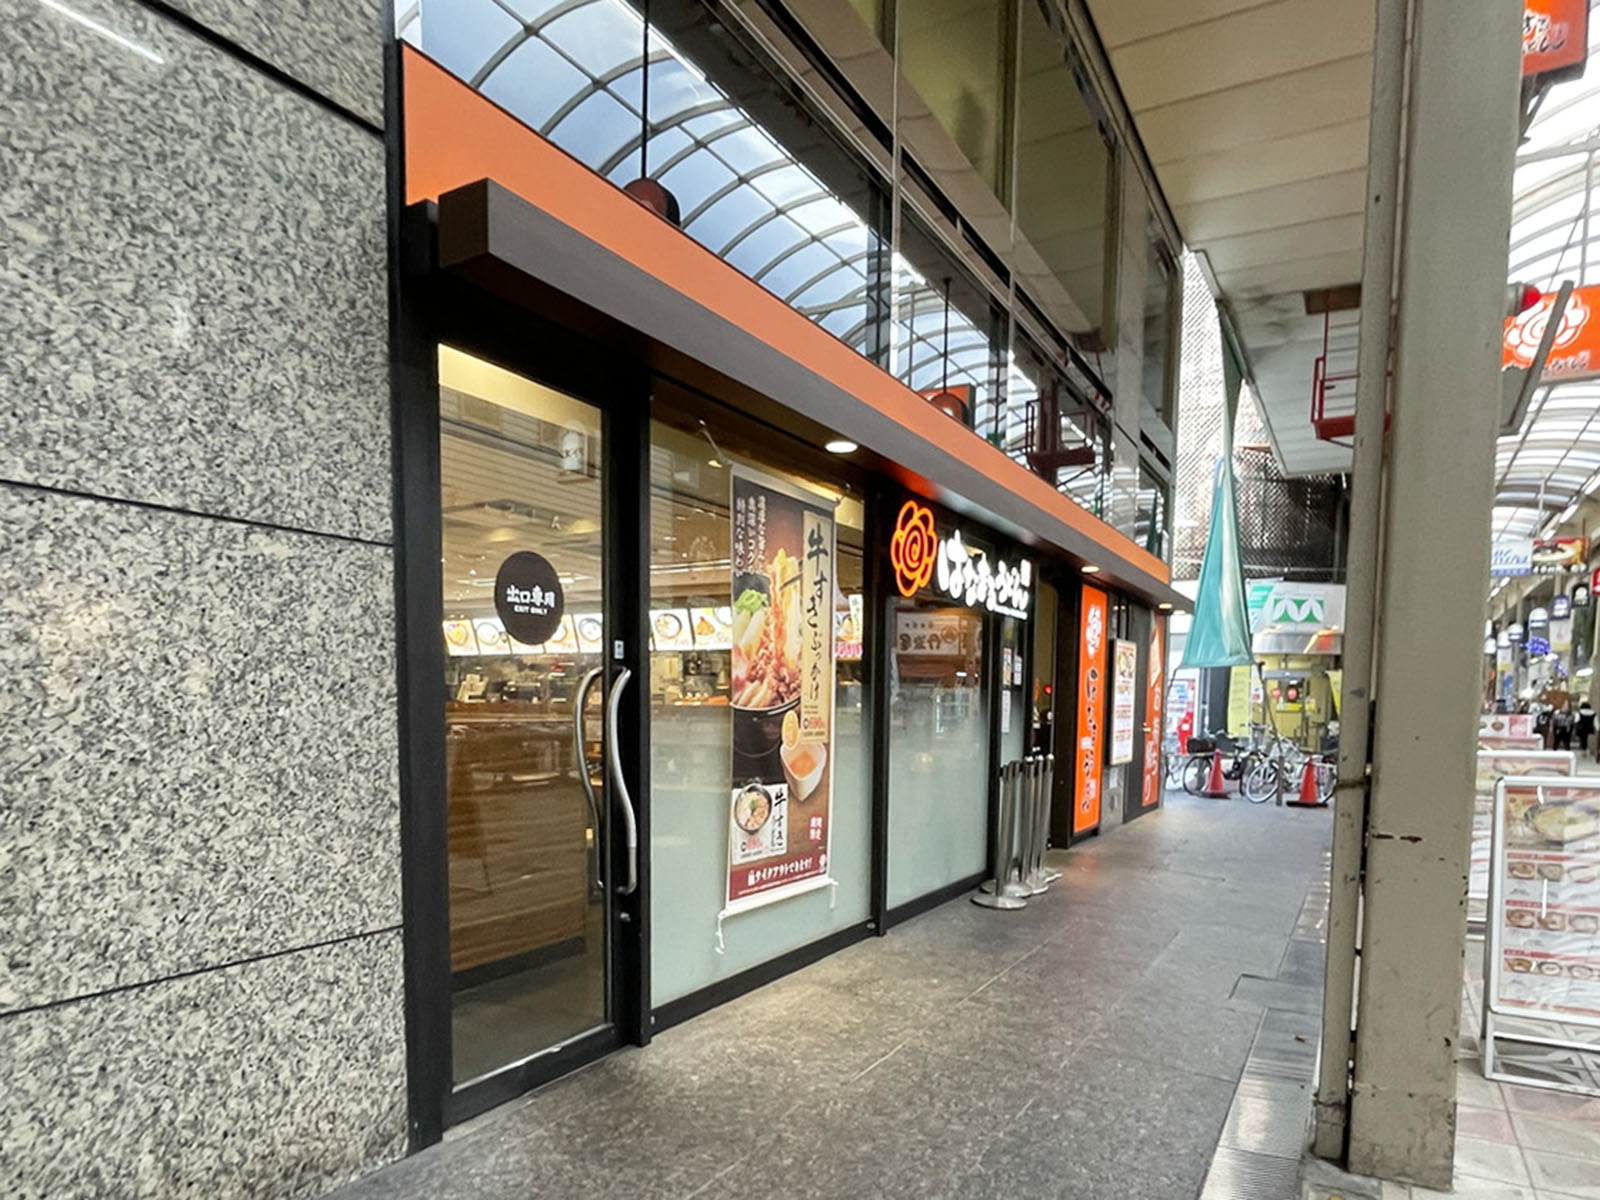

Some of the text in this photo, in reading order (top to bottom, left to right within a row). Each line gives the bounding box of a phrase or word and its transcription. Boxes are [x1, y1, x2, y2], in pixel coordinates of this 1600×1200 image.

[506, 585, 555, 608] 出口専用
[514, 605, 548, 615] EXIT ONLY
